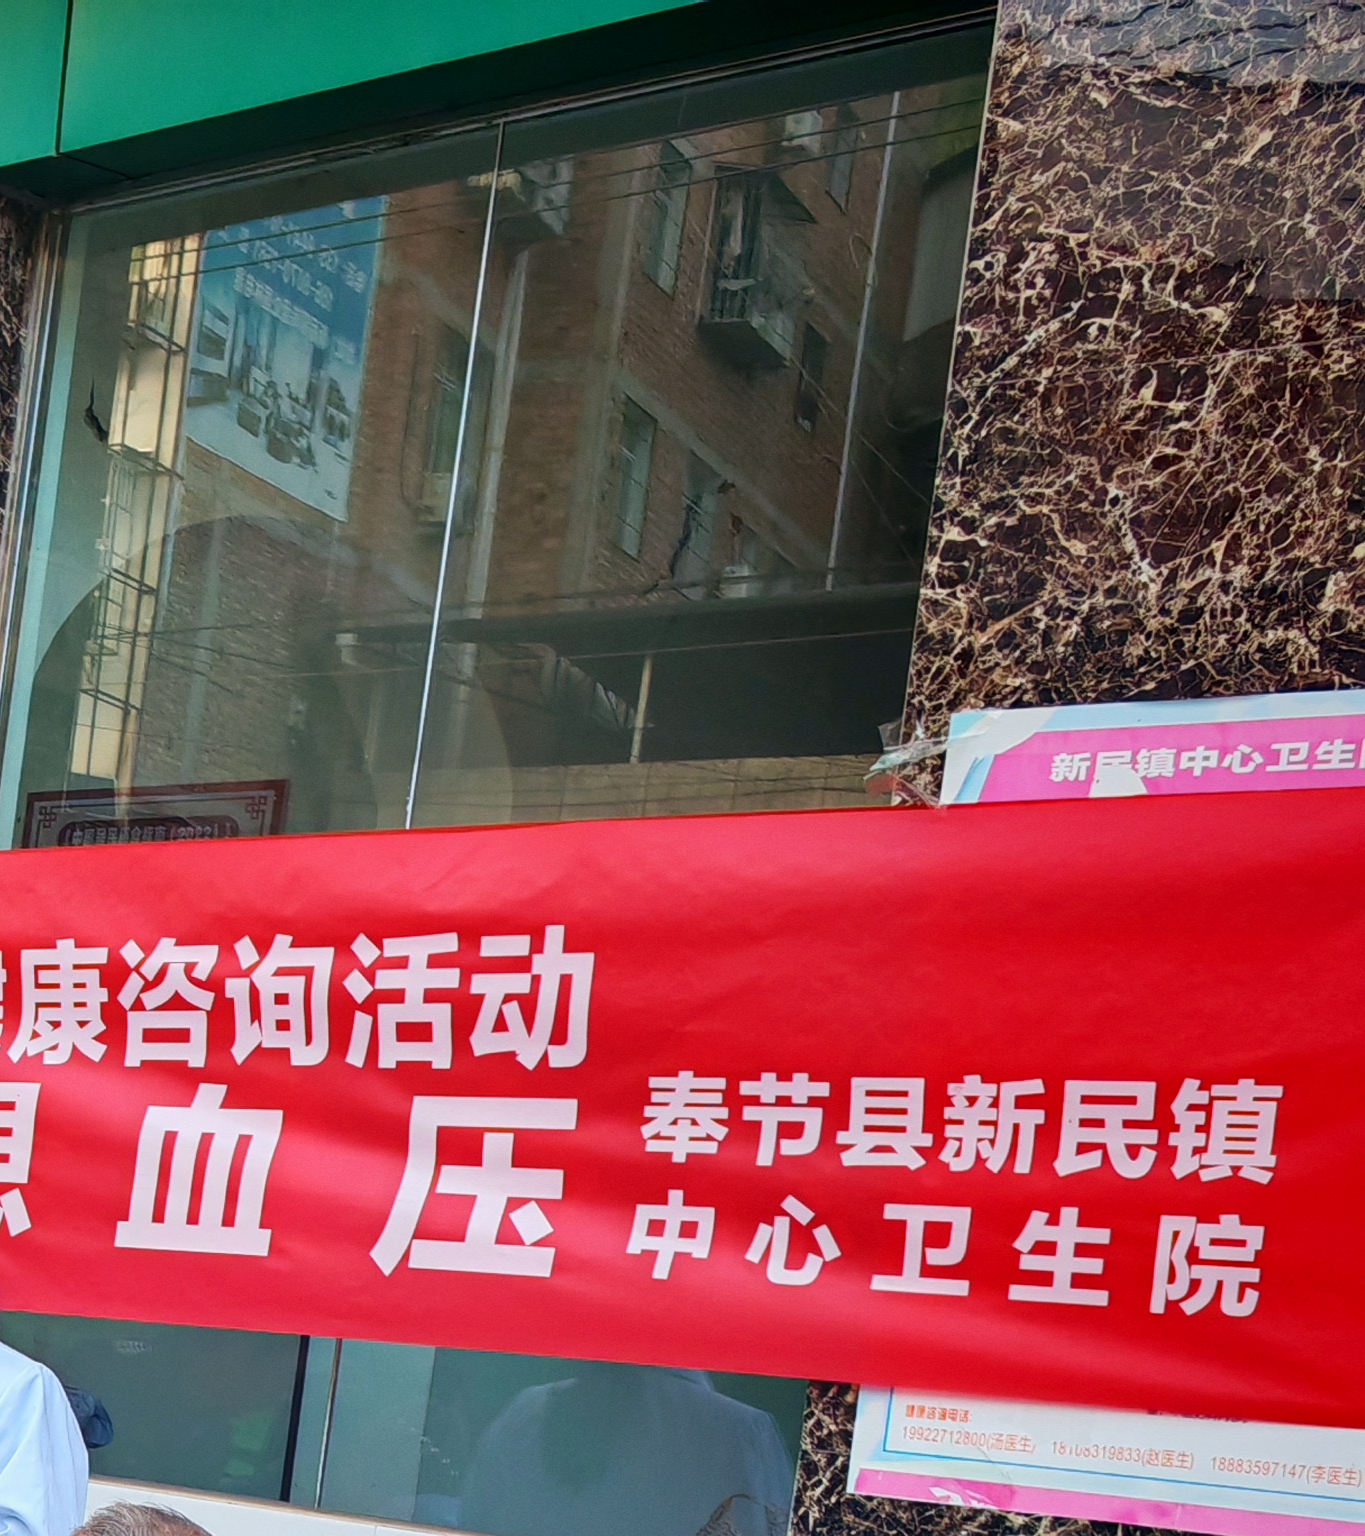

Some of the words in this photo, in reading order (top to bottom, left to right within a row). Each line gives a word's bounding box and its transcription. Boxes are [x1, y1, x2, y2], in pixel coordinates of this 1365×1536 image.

[1049, 738, 1365, 783] 新民镇中心卫生
[639, 1070, 1284, 1185] 奉节县新民镇
[625, 1189, 1266, 1318] 中心卫生院
